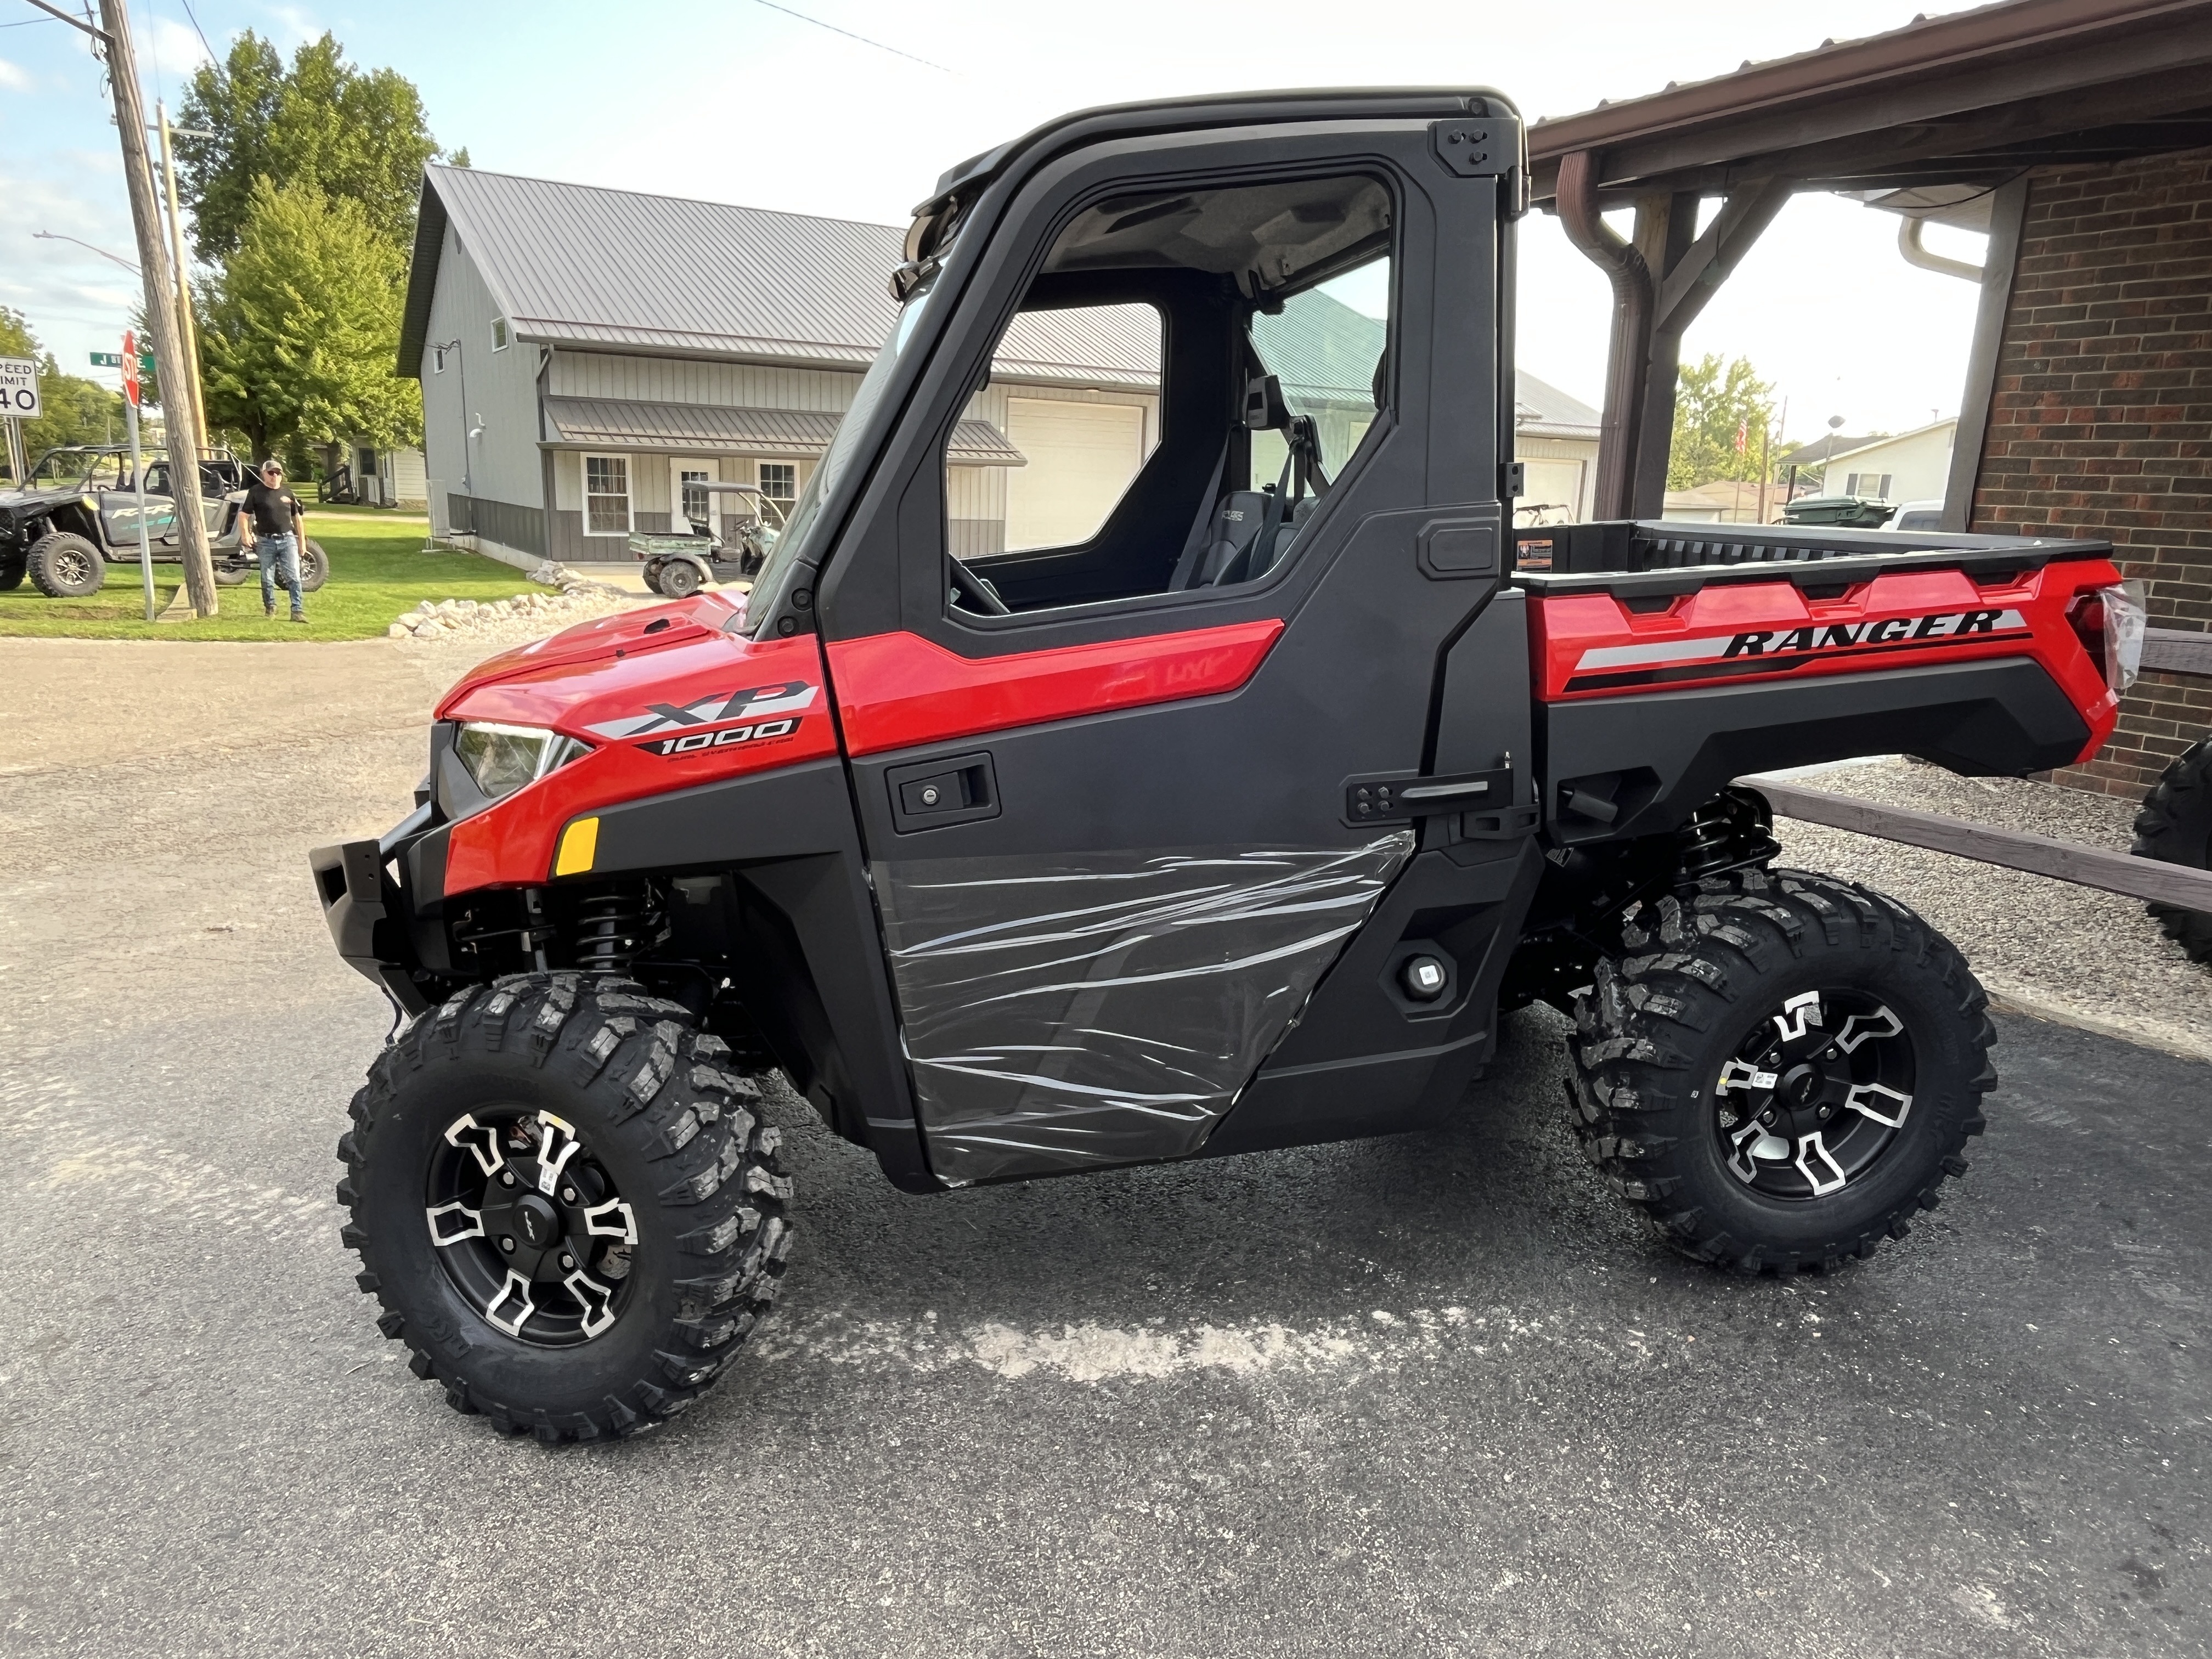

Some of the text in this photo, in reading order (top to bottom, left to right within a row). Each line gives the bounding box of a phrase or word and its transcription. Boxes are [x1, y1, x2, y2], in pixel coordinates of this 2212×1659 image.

[0, 376, 27, 386] IMIT
[0, 388, 35, 410] 40
[1721, 610, 2004, 658] RANGER
[620, 681, 811, 737] XP
[662, 719, 793, 755] 1000
